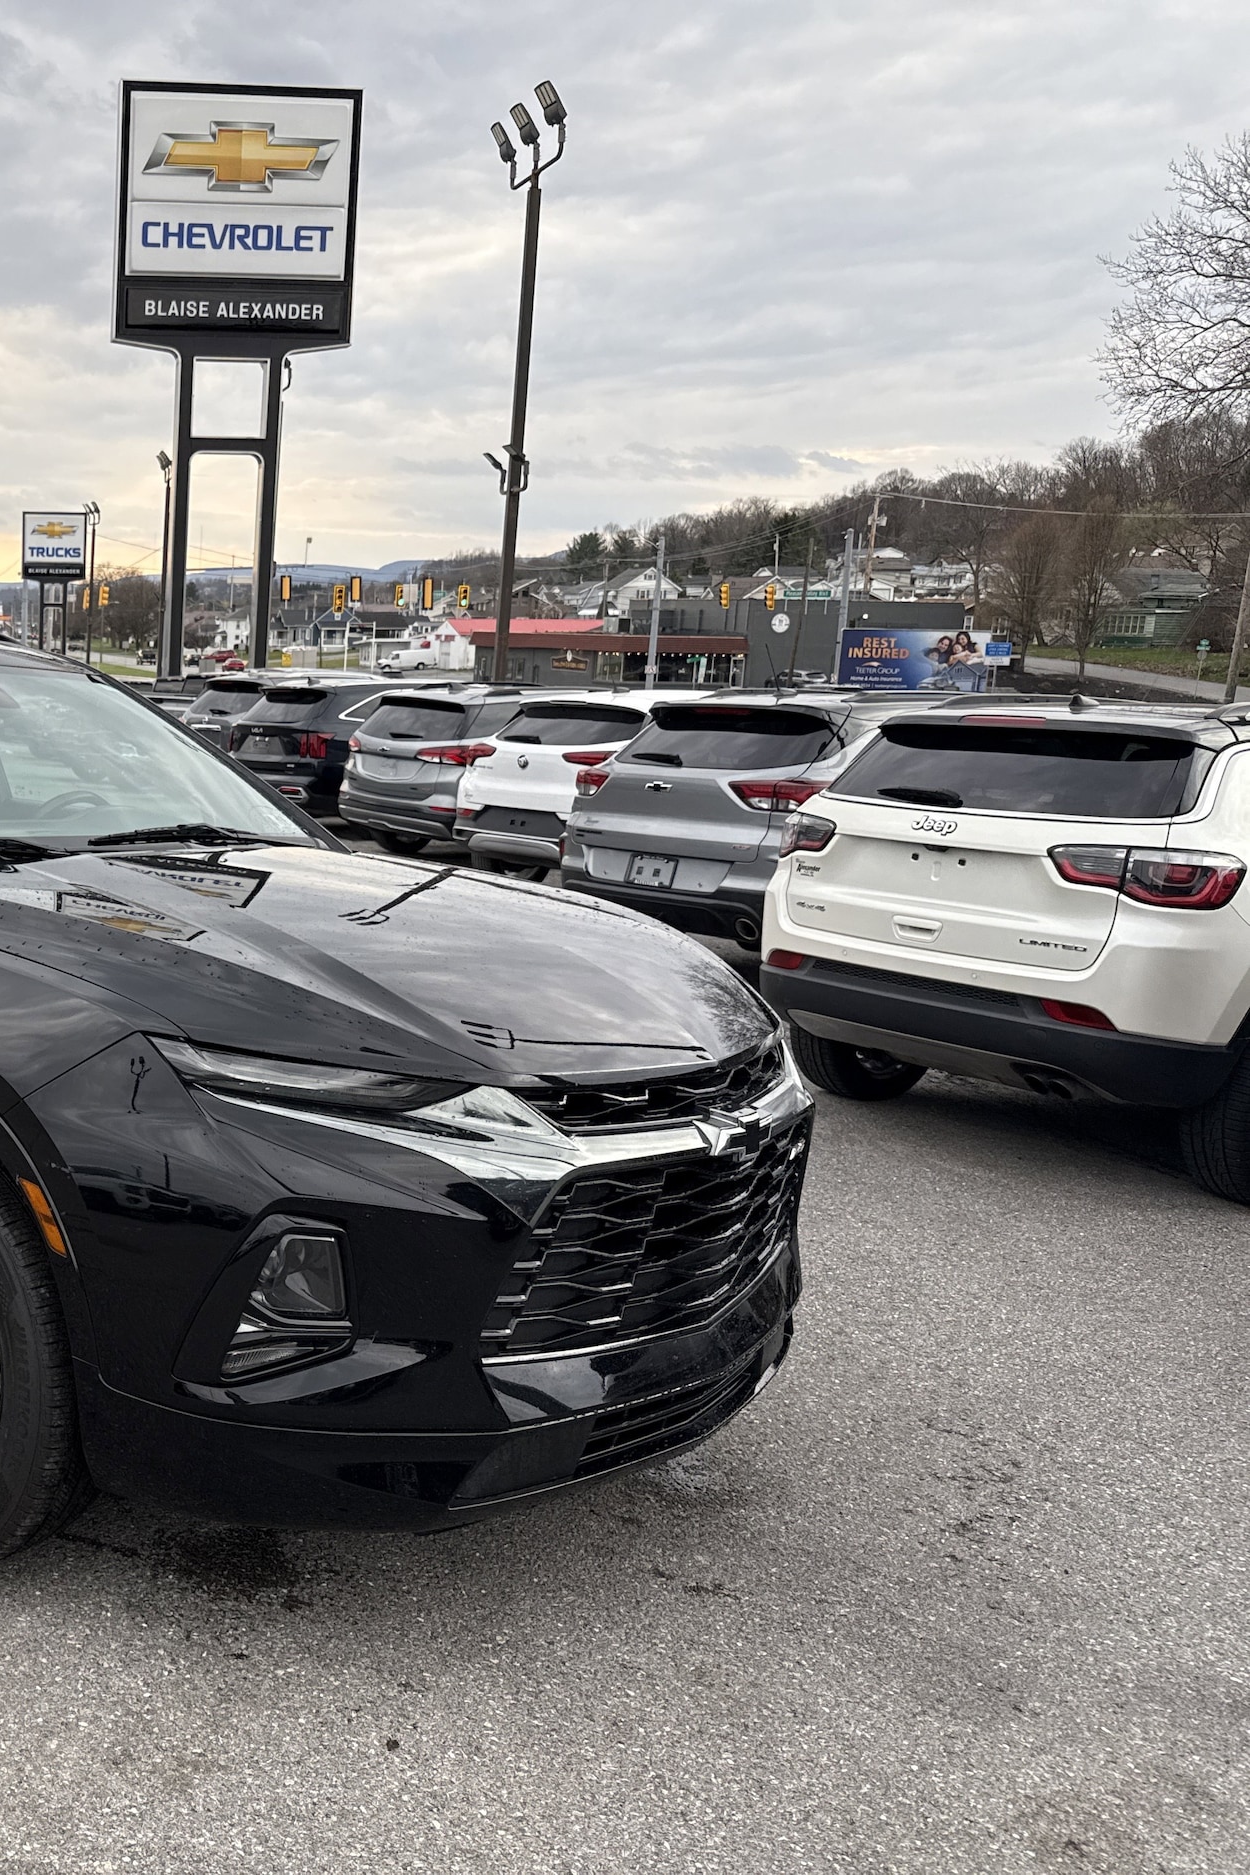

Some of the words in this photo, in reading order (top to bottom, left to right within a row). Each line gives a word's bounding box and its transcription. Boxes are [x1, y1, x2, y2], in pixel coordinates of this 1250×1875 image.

[141, 221, 334, 252] CHEVROLET
[144, 299, 209, 317] BLAISE
[216, 302, 324, 320] ALEXANDER
[28, 546, 81, 558] TRUCKS
[863, 637, 897, 648] REST
[848, 647, 910, 660] INSURED
[877, 667, 901, 675] GROUP
[911, 815, 958, 836] Jeep
[1019, 938, 1088, 953] LIMITED
